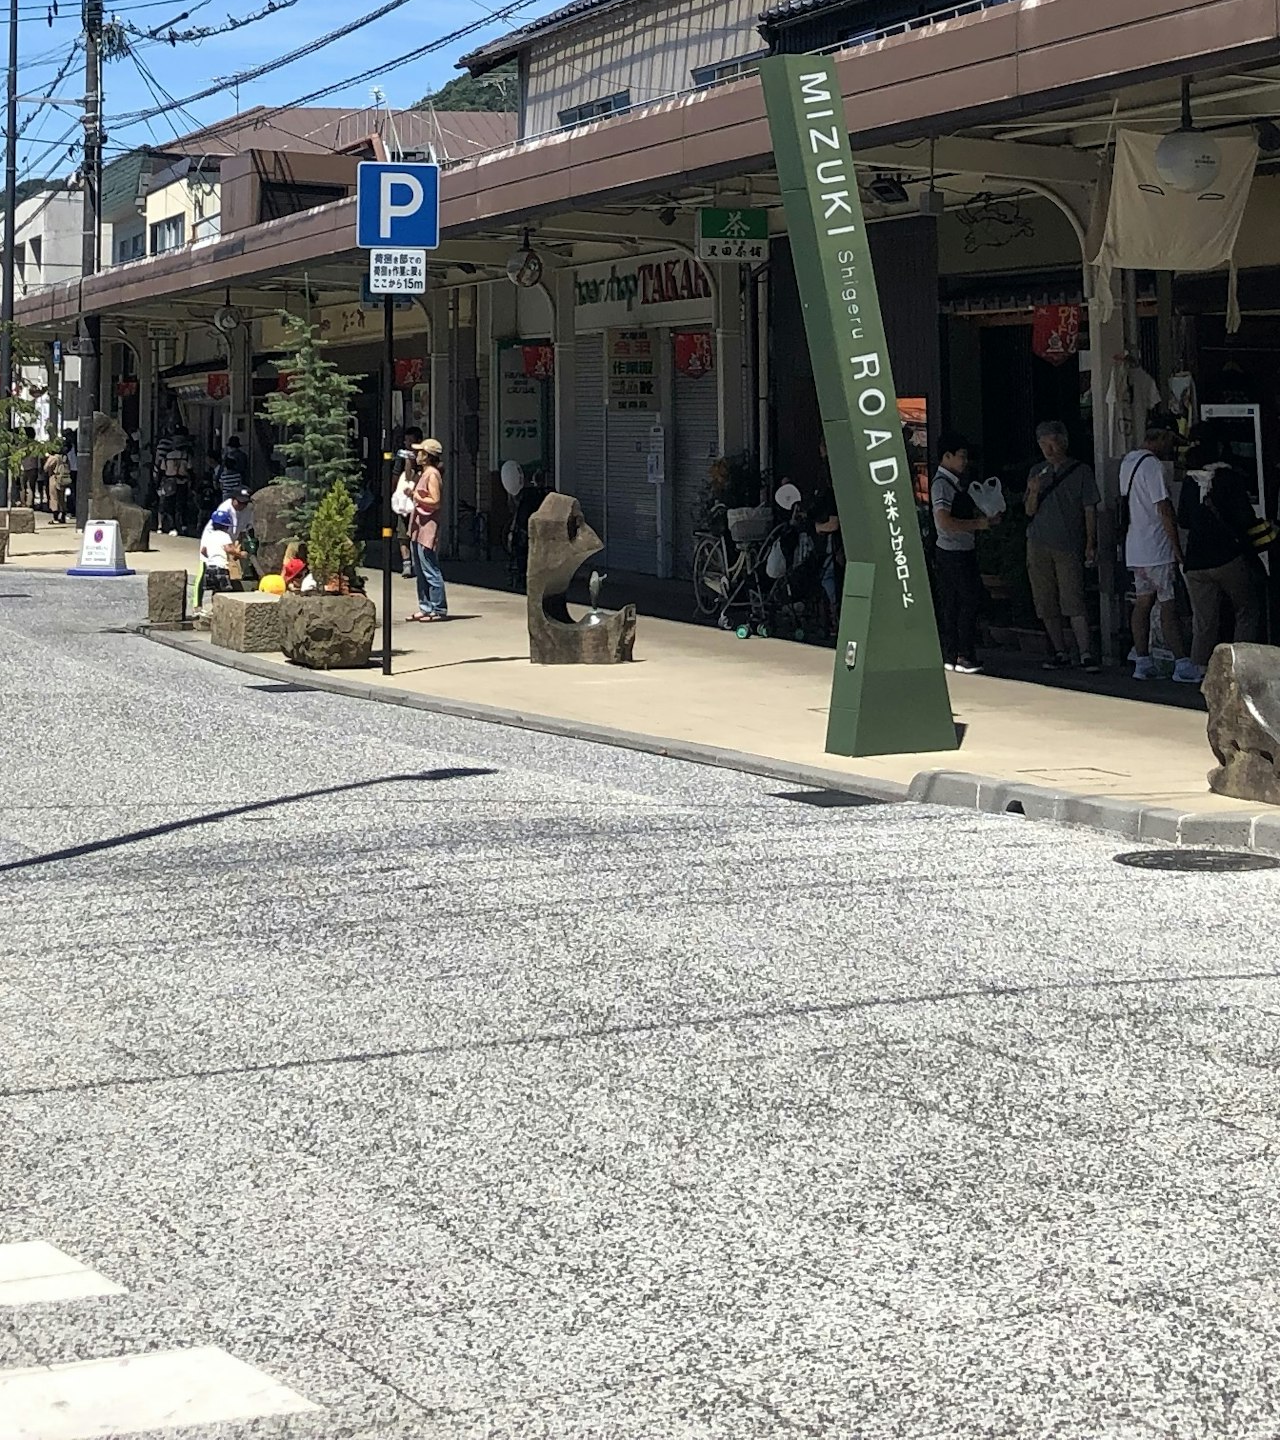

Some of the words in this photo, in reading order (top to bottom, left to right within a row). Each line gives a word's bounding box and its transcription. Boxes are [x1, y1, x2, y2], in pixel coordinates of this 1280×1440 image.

[799, 71, 856, 236] MIZUKI
[380, 172, 424, 238] P
[720, 211, 751, 237] 茶
[837, 250, 864, 340] Shigeru
[505, 426, 537, 439] タカラ
[850, 352, 898, 485] ROAD
[883, 490, 915, 609] 水木しげるロード
